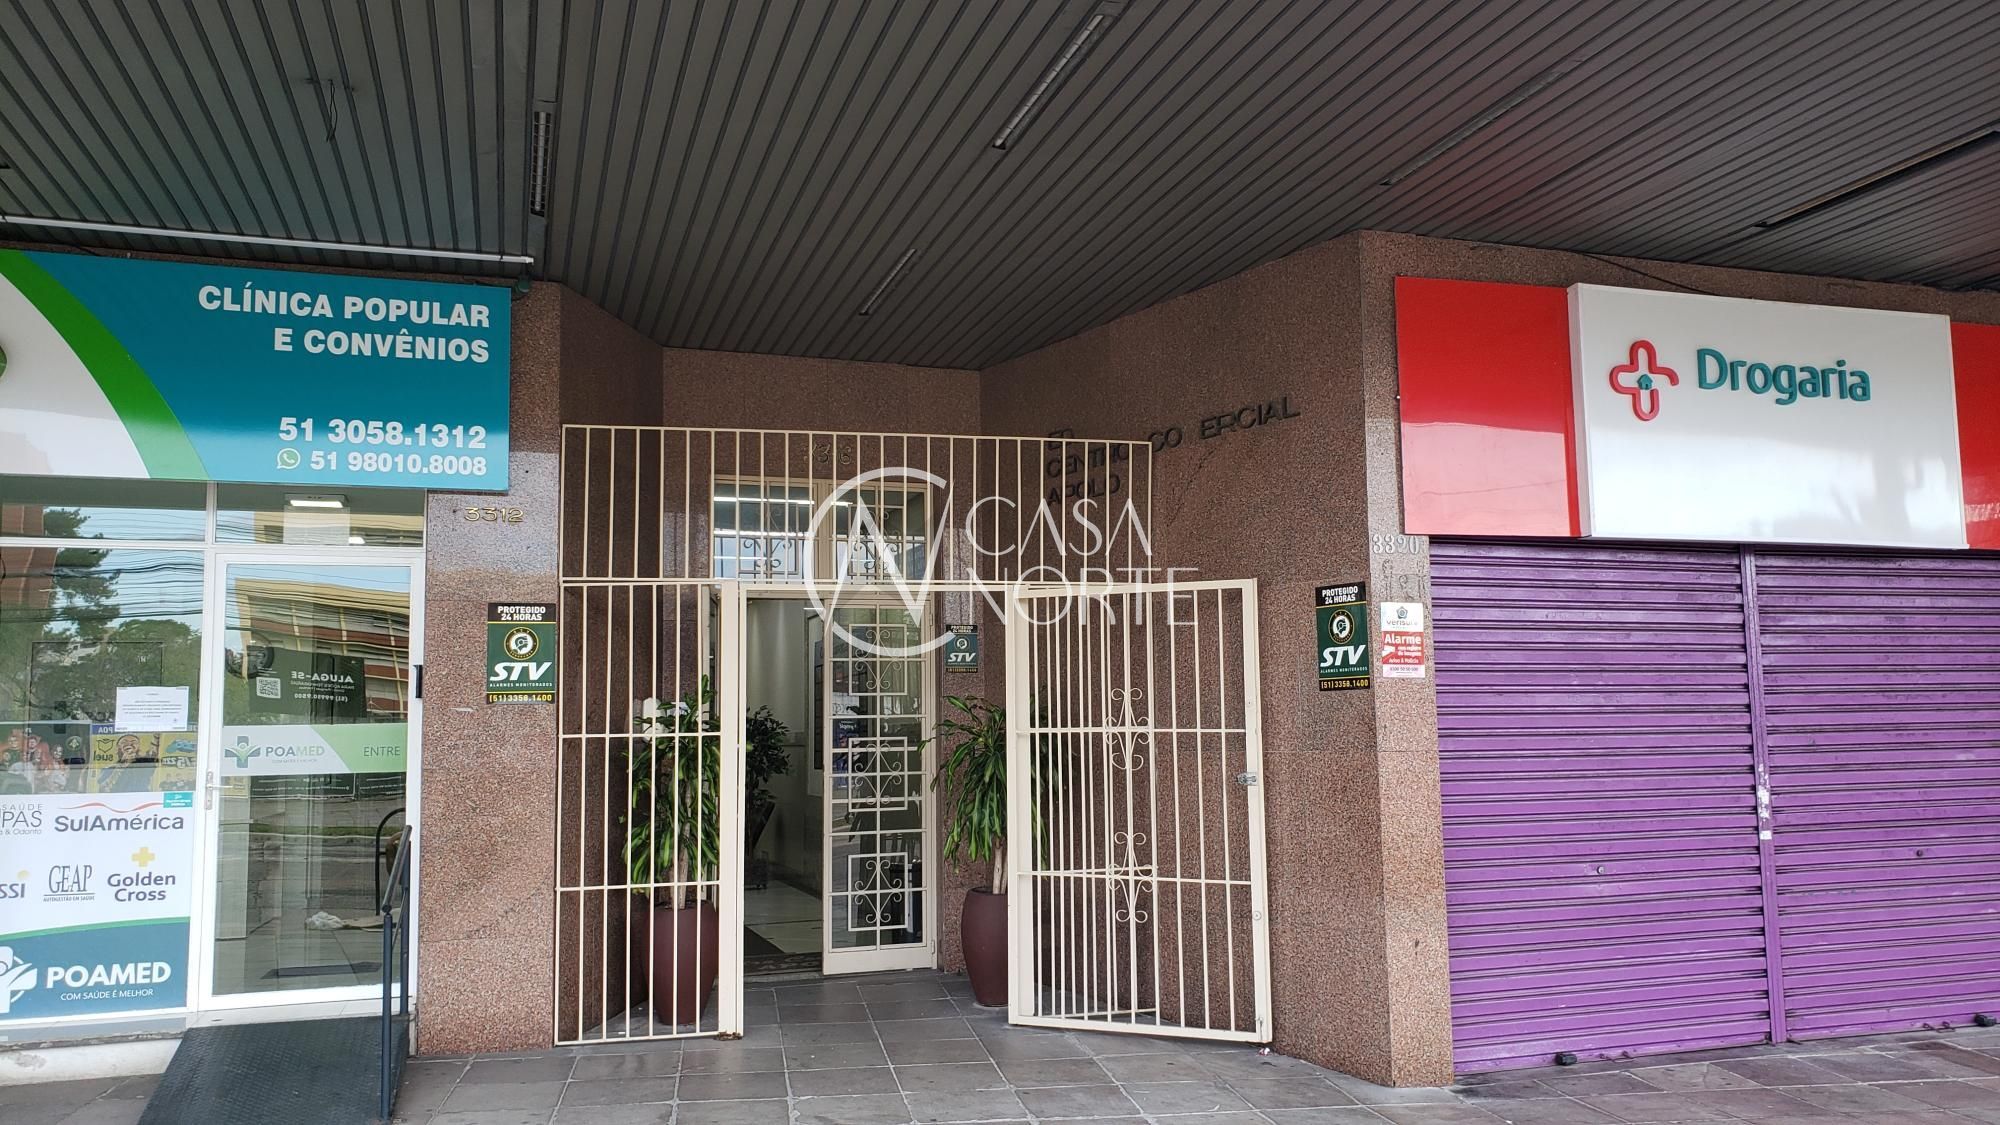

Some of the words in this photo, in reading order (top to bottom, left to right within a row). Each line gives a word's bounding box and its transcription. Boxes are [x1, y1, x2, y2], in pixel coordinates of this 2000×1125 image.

[199, 282, 333, 317] CLÍNICA
[344, 296, 489, 327] POPULAR
[274, 328, 293, 351] E
[304, 329, 489, 363] CONVÊNIOS
[1697, 348, 1871, 405] Drogaria
[279, 417, 313, 441] 51
[328, 419, 486, 448] 3058.1312
[310, 451, 337, 470] 51
[348, 452, 486, 475] 98010.8008
[464, 507, 524, 522] 3312
[1322, 585, 1358, 598] PROTEGIDO
[1325, 596, 1333, 604] 24
[1334, 594, 1356, 603] HORAS
[497, 606, 546, 614] PROTEGIDO
[1385, 633, 1422, 644] Alarme
[948, 653, 976, 662] STV
[1320, 645, 1366, 667] STV
[489, 662, 552, 681] STV
[265, 746, 325, 758] POAMED
[363, 746, 401, 757] ENTRE
[54, 814, 185, 832] SulAmérica
[49, 864, 93, 893] GEAP
[107, 872, 176, 887] Golden
[114, 888, 167, 902] Cross
[47, 962, 172, 989] POAMED
[61, 992, 81, 1001] COM
[83, 990, 110, 1000] SAÚDE
[112, 989, 117, 998] É
[119, 988, 154, 998] MELHOR
